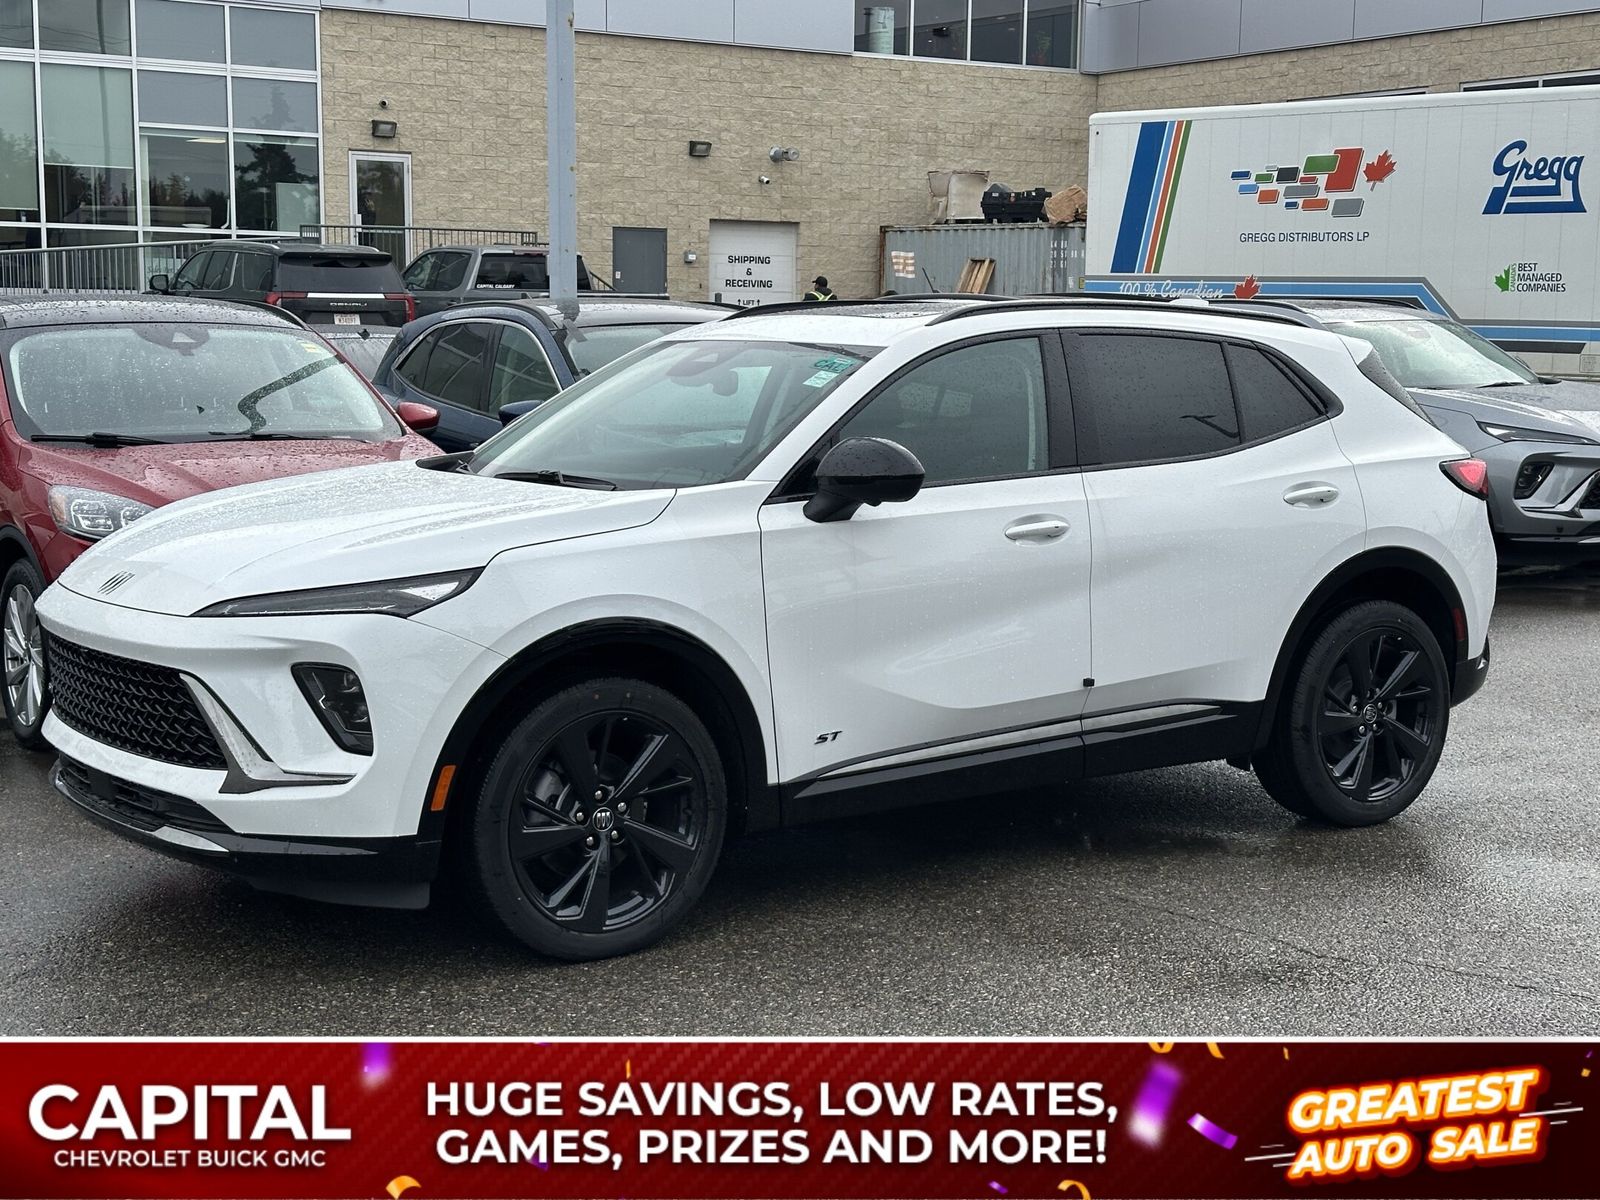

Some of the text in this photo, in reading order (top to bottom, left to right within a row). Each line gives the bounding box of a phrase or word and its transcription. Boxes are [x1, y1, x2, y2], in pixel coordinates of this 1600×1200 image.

[1482, 139, 1587, 214] Gregg
[1239, 231, 1370, 243] GREGG DISTRIBUTORS LP
[727, 255, 771, 265] SHIPPING
[745, 267, 753, 276] &
[1517, 262, 1538, 271] BEST
[1516, 273, 1563, 281] MANAGED
[725, 278, 773, 289] RECEIVING
[1516, 283, 1566, 293] COMPANIES
[1119, 282, 1140, 295] 100
[1160, 280, 1223, 298] Canadian
[814, 730, 843, 745] ST
